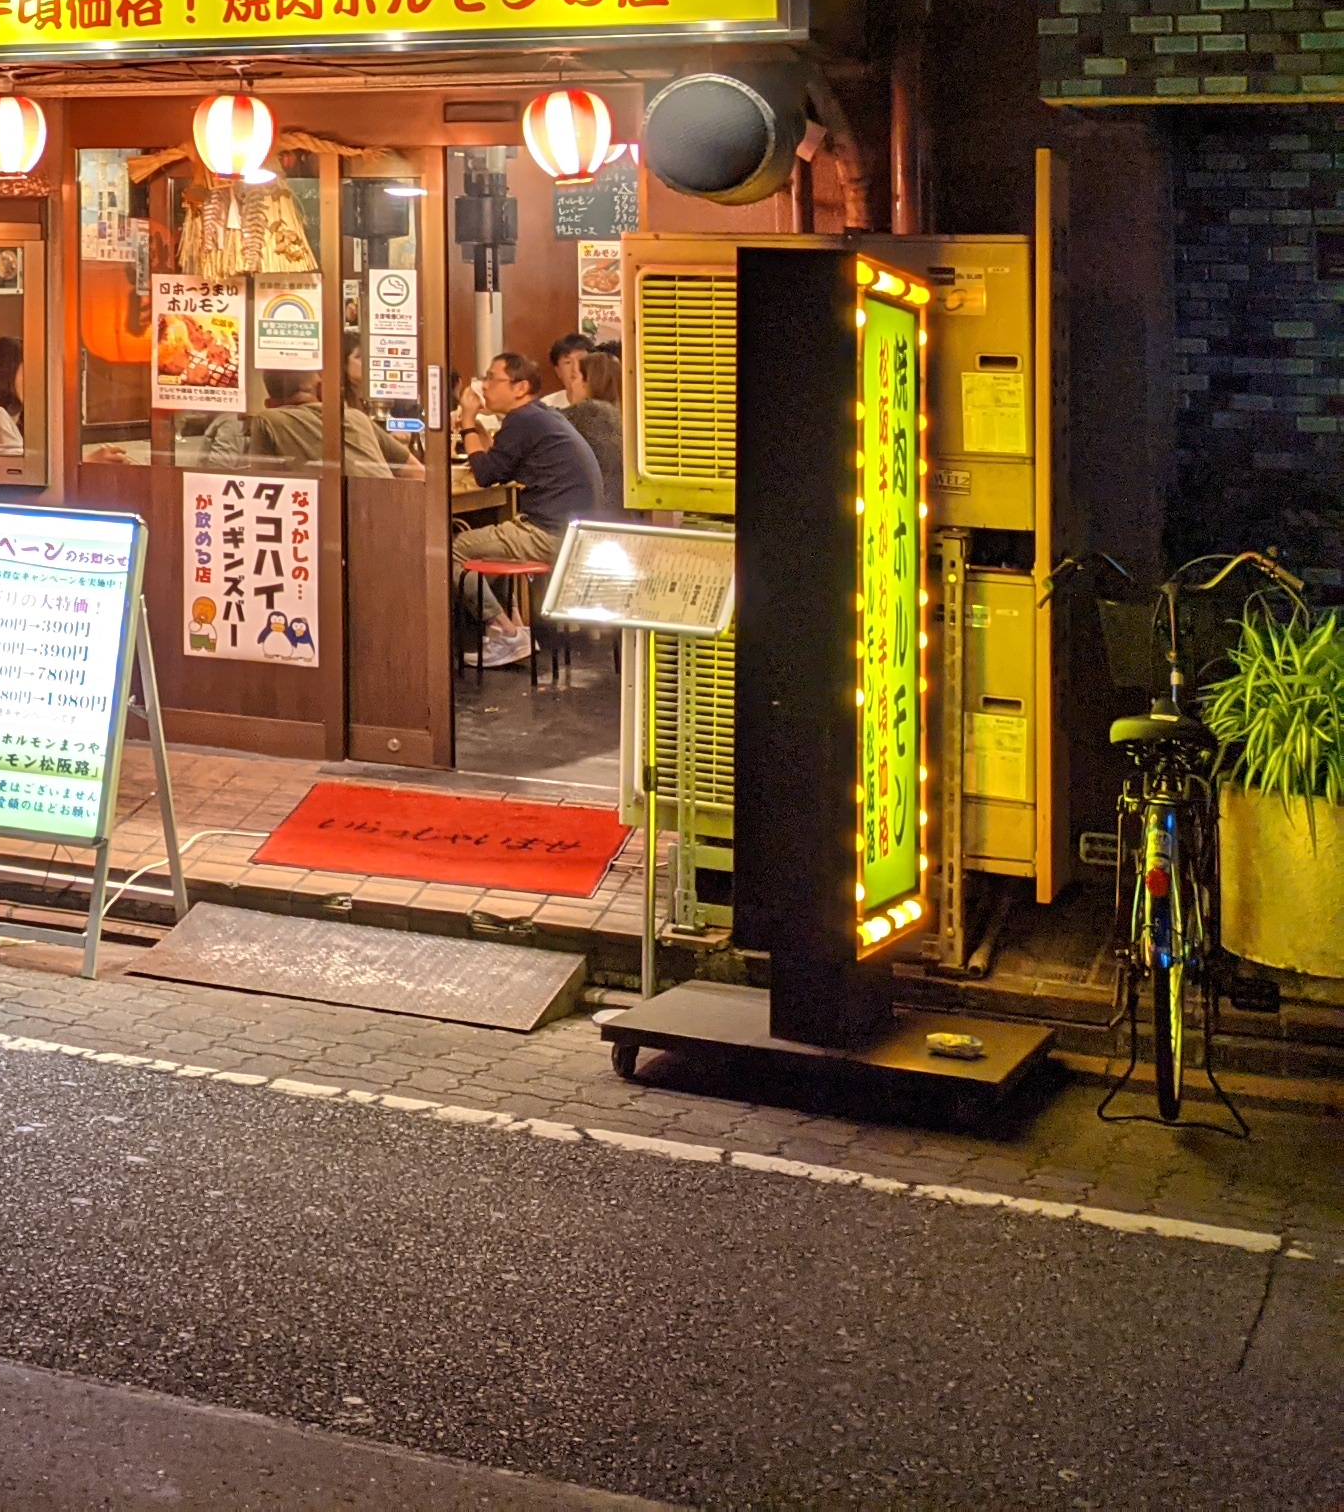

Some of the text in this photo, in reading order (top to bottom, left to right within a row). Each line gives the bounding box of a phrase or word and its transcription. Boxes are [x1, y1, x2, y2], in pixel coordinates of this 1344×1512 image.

[159, 282, 239, 297] 日本一うまい
[167, 297, 230, 313] ホルモン
[195, 494, 212, 584] が飲める店
[252, 482, 285, 610] タコハイ
[222, 480, 245, 647] ペンギンズバー
[893, 332, 908, 847] 焼肉ホルモン
[41, 619, 91, 637] 390円
[40, 643, 89, 662] 390円
[38, 666, 86, 686] 780円
